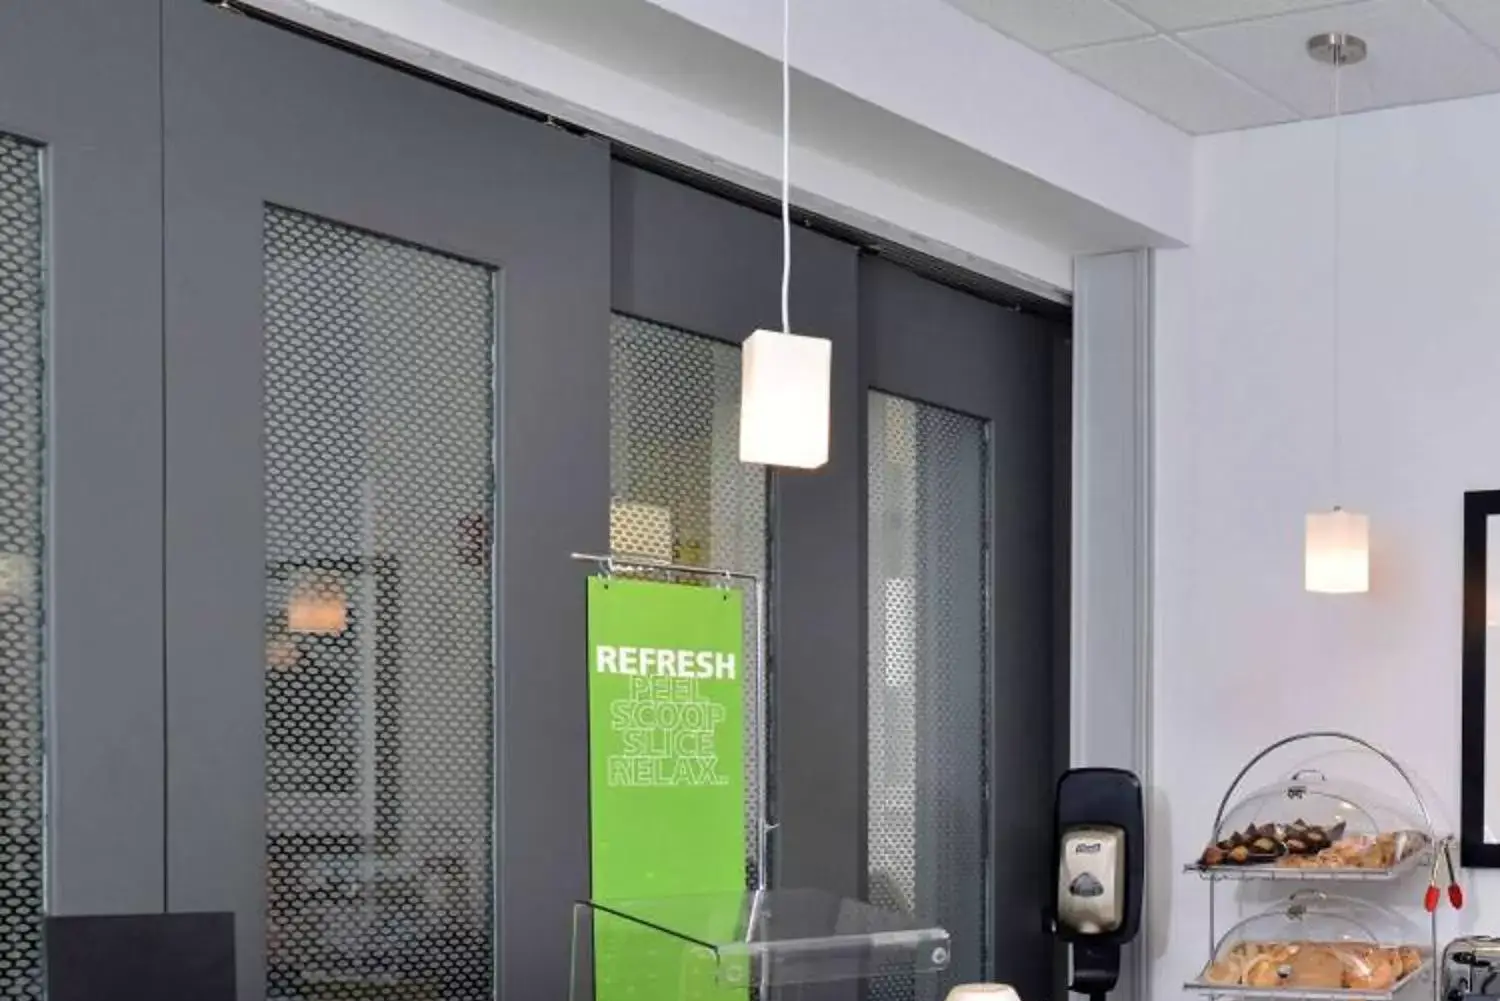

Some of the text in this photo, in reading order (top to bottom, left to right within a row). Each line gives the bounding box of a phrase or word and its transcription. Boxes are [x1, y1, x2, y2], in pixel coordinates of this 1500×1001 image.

[596, 645, 736, 680] REFRESH
[630, 673, 711, 703] PEEL
[609, 699, 726, 732] SCOOP
[623, 728, 715, 759] SLICE
[608, 754, 729, 786] RELAX.
